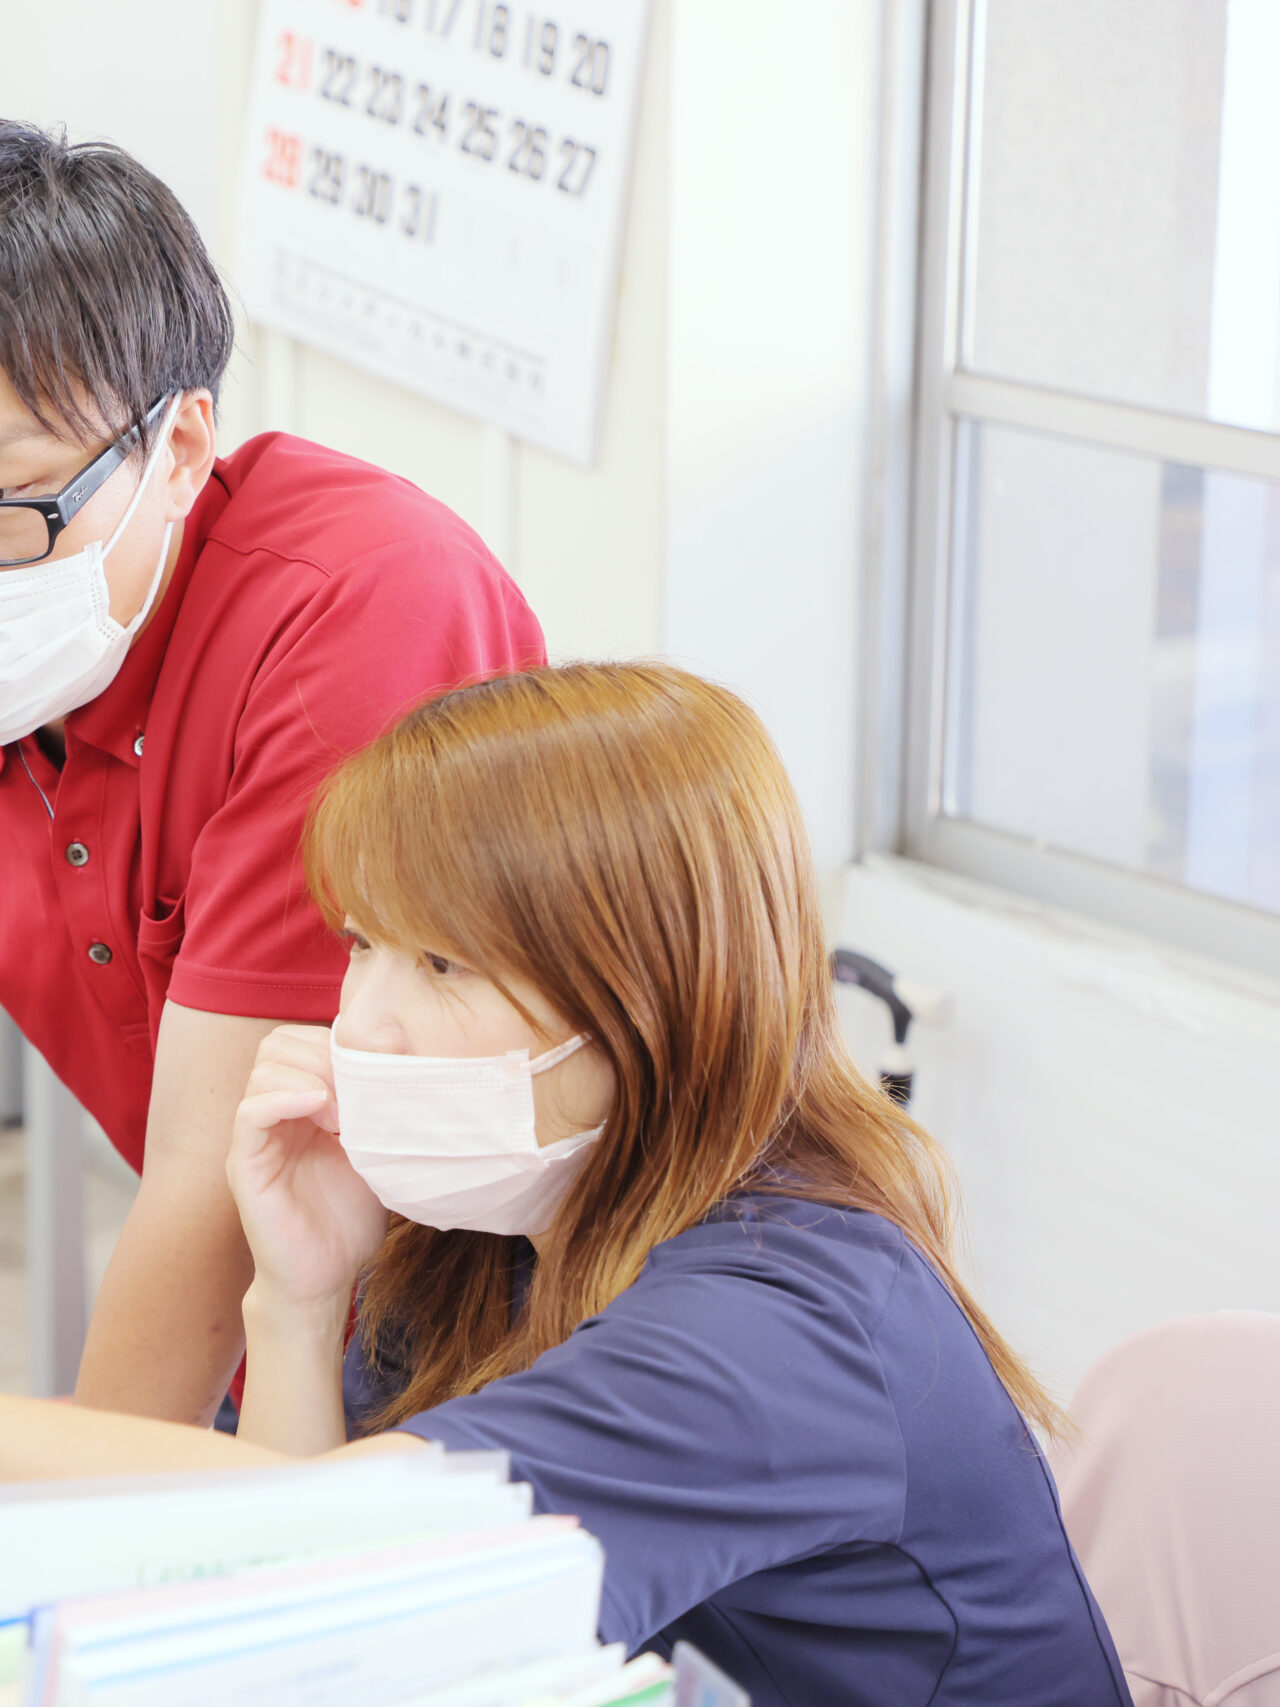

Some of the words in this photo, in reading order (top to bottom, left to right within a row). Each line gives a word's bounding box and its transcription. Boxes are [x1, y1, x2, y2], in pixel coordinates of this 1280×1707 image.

[474, 1, 510, 60] 18
[524, 14, 558, 77] 19
[569, 33, 610, 96] 20
[277, 32, 313, 90] 21
[322, 49, 357, 108] 22
[366, 66, 404, 126] 23
[412, 83, 451, 142] 24
[460, 101, 500, 163] 25
[508, 120, 549, 182] 26
[556, 138, 599, 199] 27
[264, 127, 302, 190] 28
[309, 148, 345, 206] 29
[353, 165, 394, 226] 30
[403, 184, 439, 245] 31
